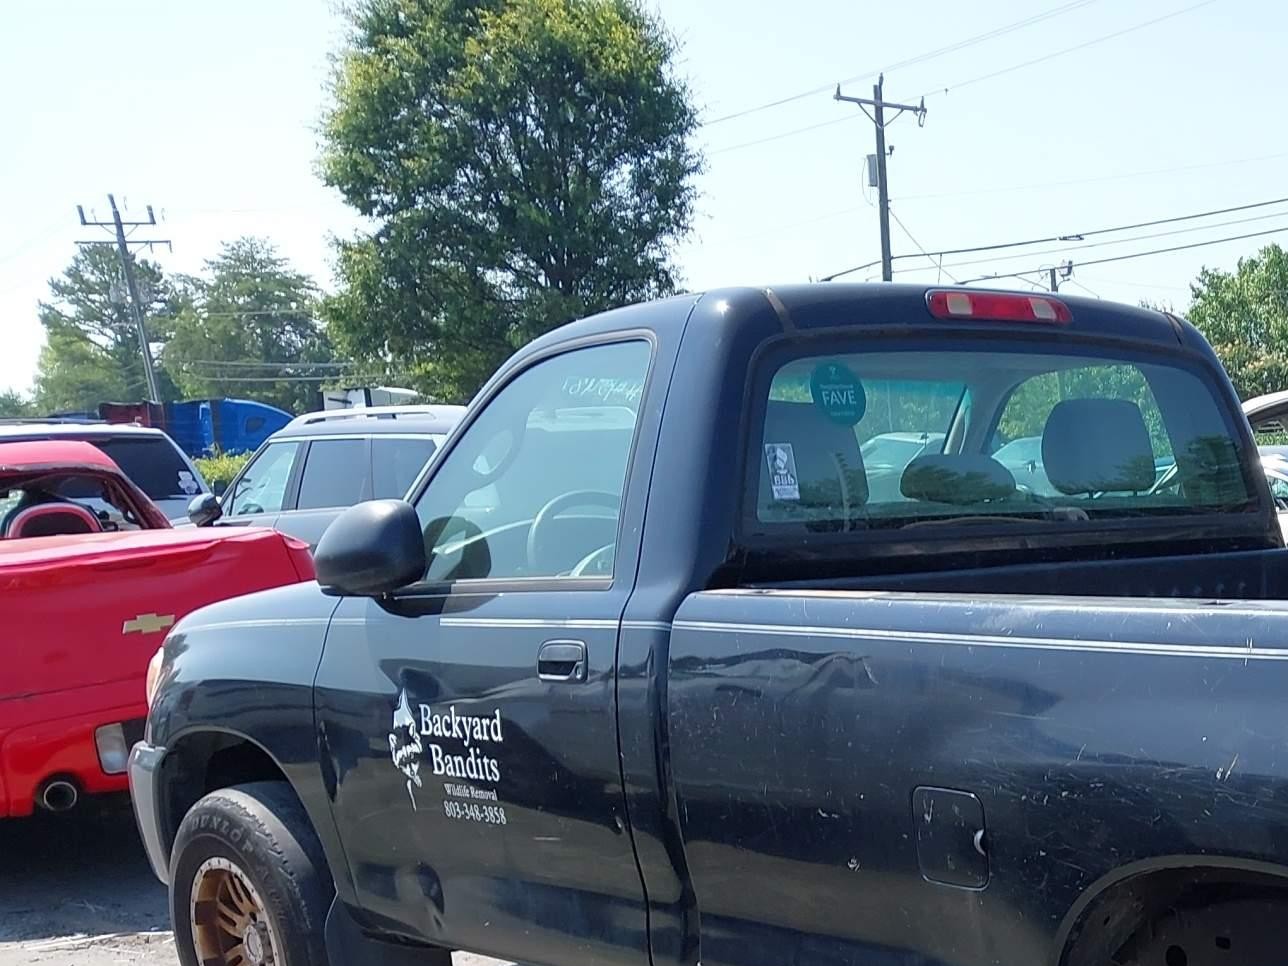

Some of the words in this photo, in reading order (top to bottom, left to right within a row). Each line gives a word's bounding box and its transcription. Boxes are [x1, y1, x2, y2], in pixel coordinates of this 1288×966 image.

[822, 389, 857, 406] FAVE
[419, 703, 503, 747] Backyard
[429, 743, 500, 782] Bandits
[444, 782, 470, 798] Wildlife
[470, 785, 498, 801] Removal
[443, 799, 507, 825] 803-348-3858
[192, 814, 254, 853] DUNLOP
